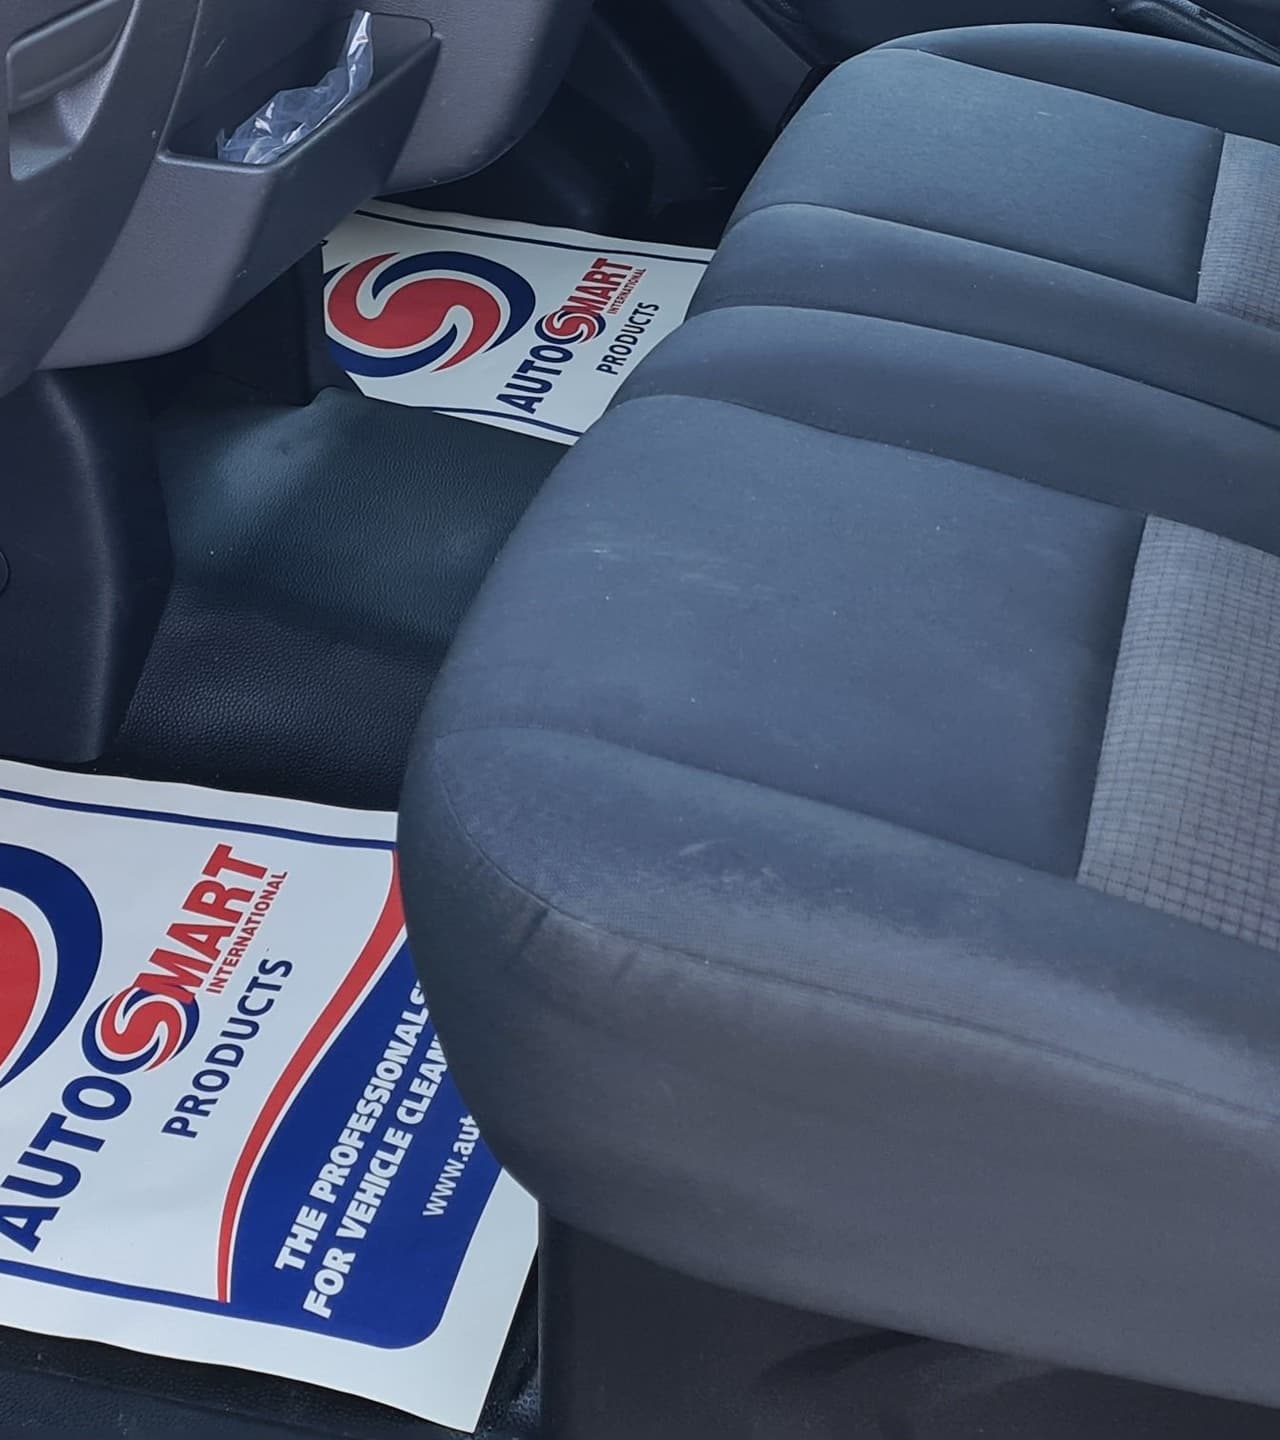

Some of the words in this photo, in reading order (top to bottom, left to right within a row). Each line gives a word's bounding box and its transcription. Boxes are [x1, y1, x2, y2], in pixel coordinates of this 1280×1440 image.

[596, 301, 660, 376] PRODUCTS
[607, 268, 647, 315] INTERNATIONAL
[207, 871, 288, 995] INTERNATIONAL
[161, 957, 294, 1139] PRODUCTS
[303, 1246, 357, 1319] FOR
[336, 1126, 414, 1241] VEHICLE
[395, 1034, 449, 1126] CLEAN
[274, 1205, 328, 1271] THE
